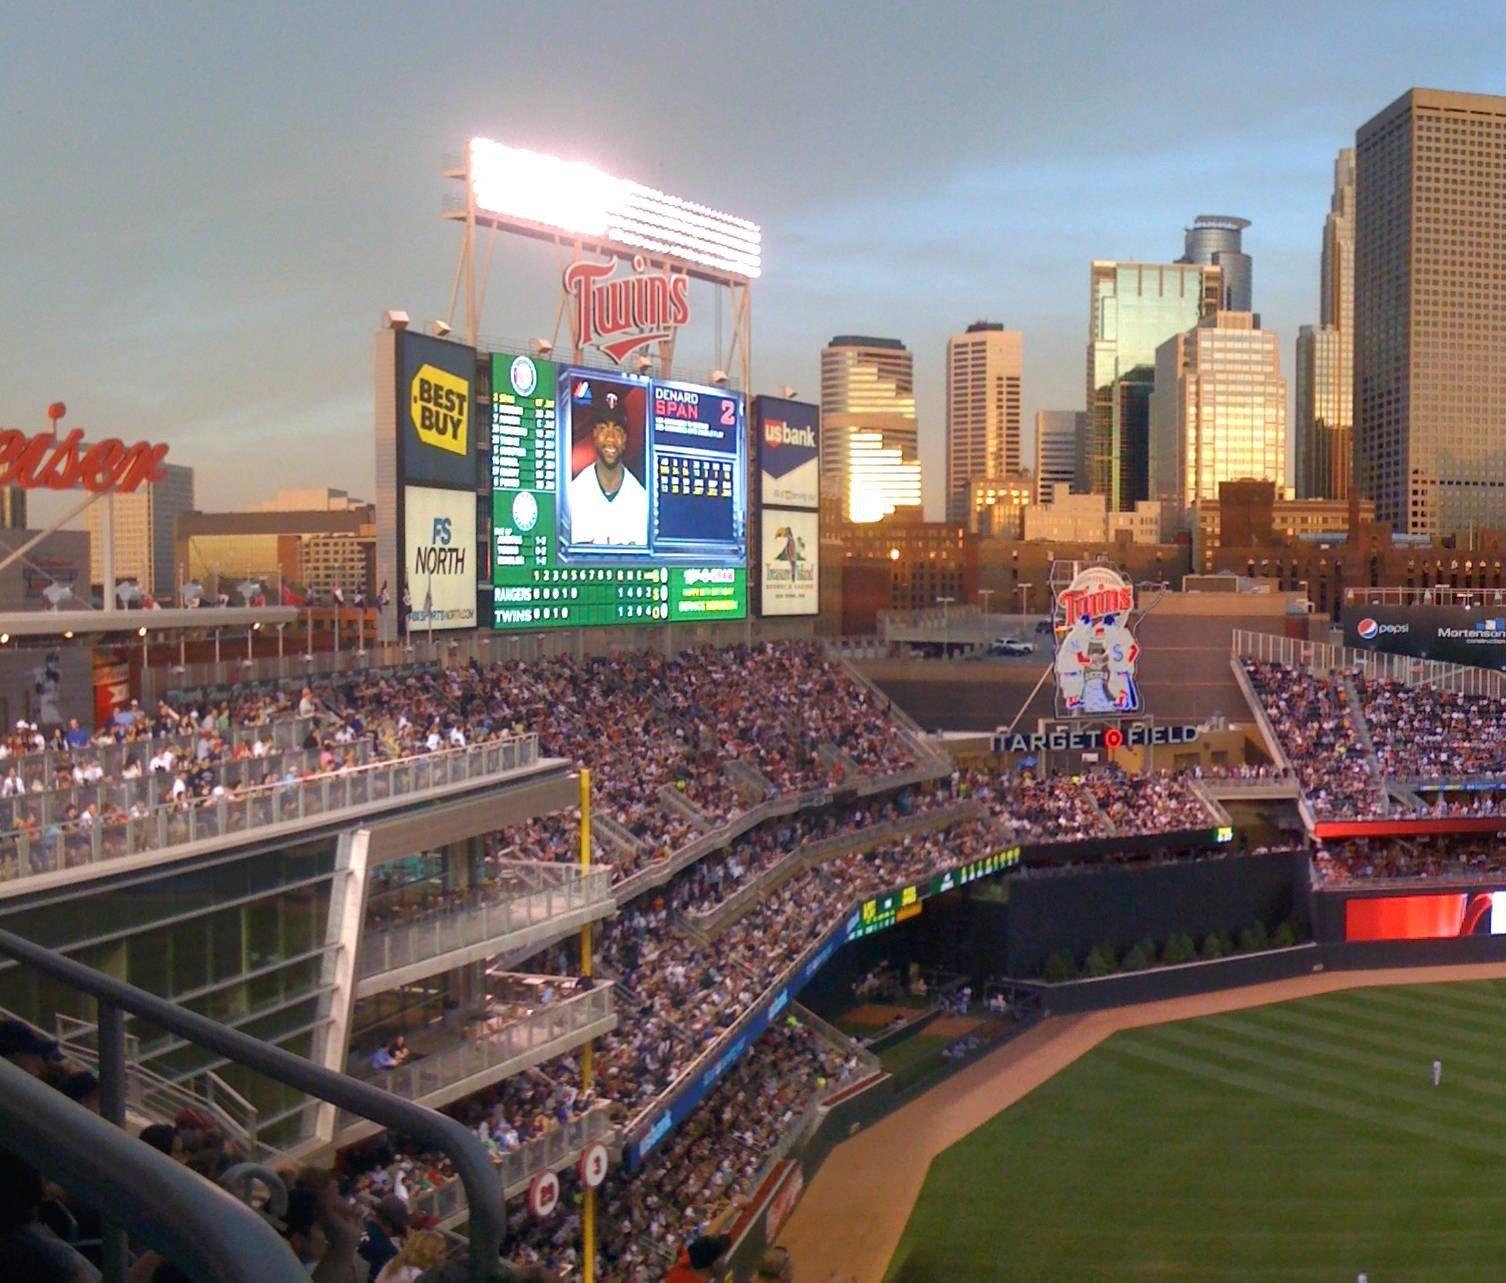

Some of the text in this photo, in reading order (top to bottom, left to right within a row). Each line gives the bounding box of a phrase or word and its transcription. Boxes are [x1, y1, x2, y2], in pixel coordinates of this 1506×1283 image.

[562, 254, 690, 349] Twins
[418, 377, 467, 417] BEST
[655, 387, 736, 426] DENARD 2
[655, 399, 699, 420] SPAN
[419, 405, 463, 441] BUY
[431, 517, 452, 547] FS
[415, 547, 465, 576] NORTH
[534, 569, 540, 581] 1
[543, 569, 550, 581] 2
[552, 569, 559, 581] 3
[561, 569, 568, 581] 4
[570, 569, 577, 581] 5
[580, 569, 586, 581] 6
[588, 569, 595, 581] 7
[494, 587, 533, 602] RANGERS
[562, 587, 568, 599] 1
[617, 587, 624, 599] 1
[1059, 585, 1133, 627] Twins
[494, 608, 533, 623] TWINS
[553, 607, 559, 618] 1
[618, 606, 624, 617] 1
[1378, 623, 1409, 636] pepsi
[1437, 627, 1506, 638] Mortenson
[994, 725, 1200, 753] TARGET FIELD
